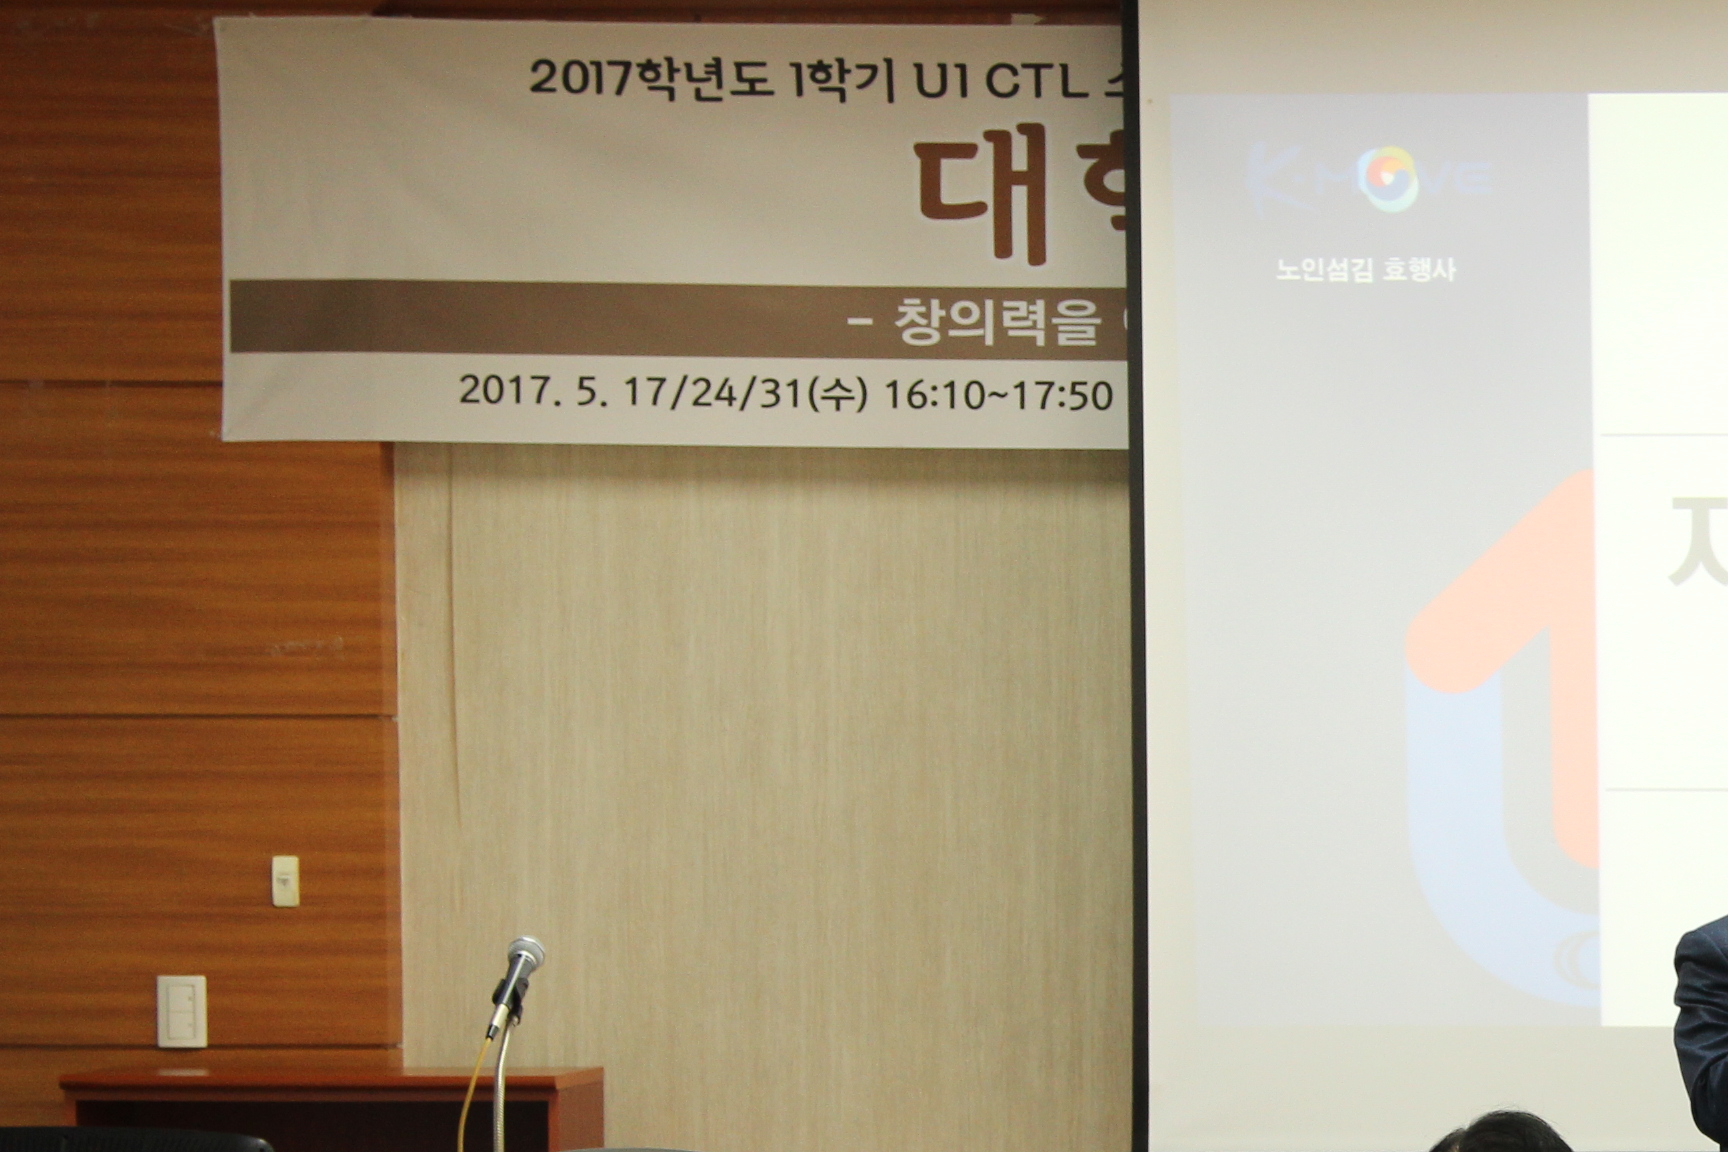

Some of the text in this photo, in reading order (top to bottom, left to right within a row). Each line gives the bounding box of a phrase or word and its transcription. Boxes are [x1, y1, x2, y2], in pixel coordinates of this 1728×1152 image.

[529, 55, 775, 103] 2017학년도
[789, 56, 895, 104] 1학기
[985, 62, 1090, 99] CTL
[1276, 256, 1458, 284] 노인섬김 효행사
[894, 297, 1102, 347] 창의력을
[459, 373, 1114, 414] 2017. 5. 17/24/31(수) 16:10~17:50
